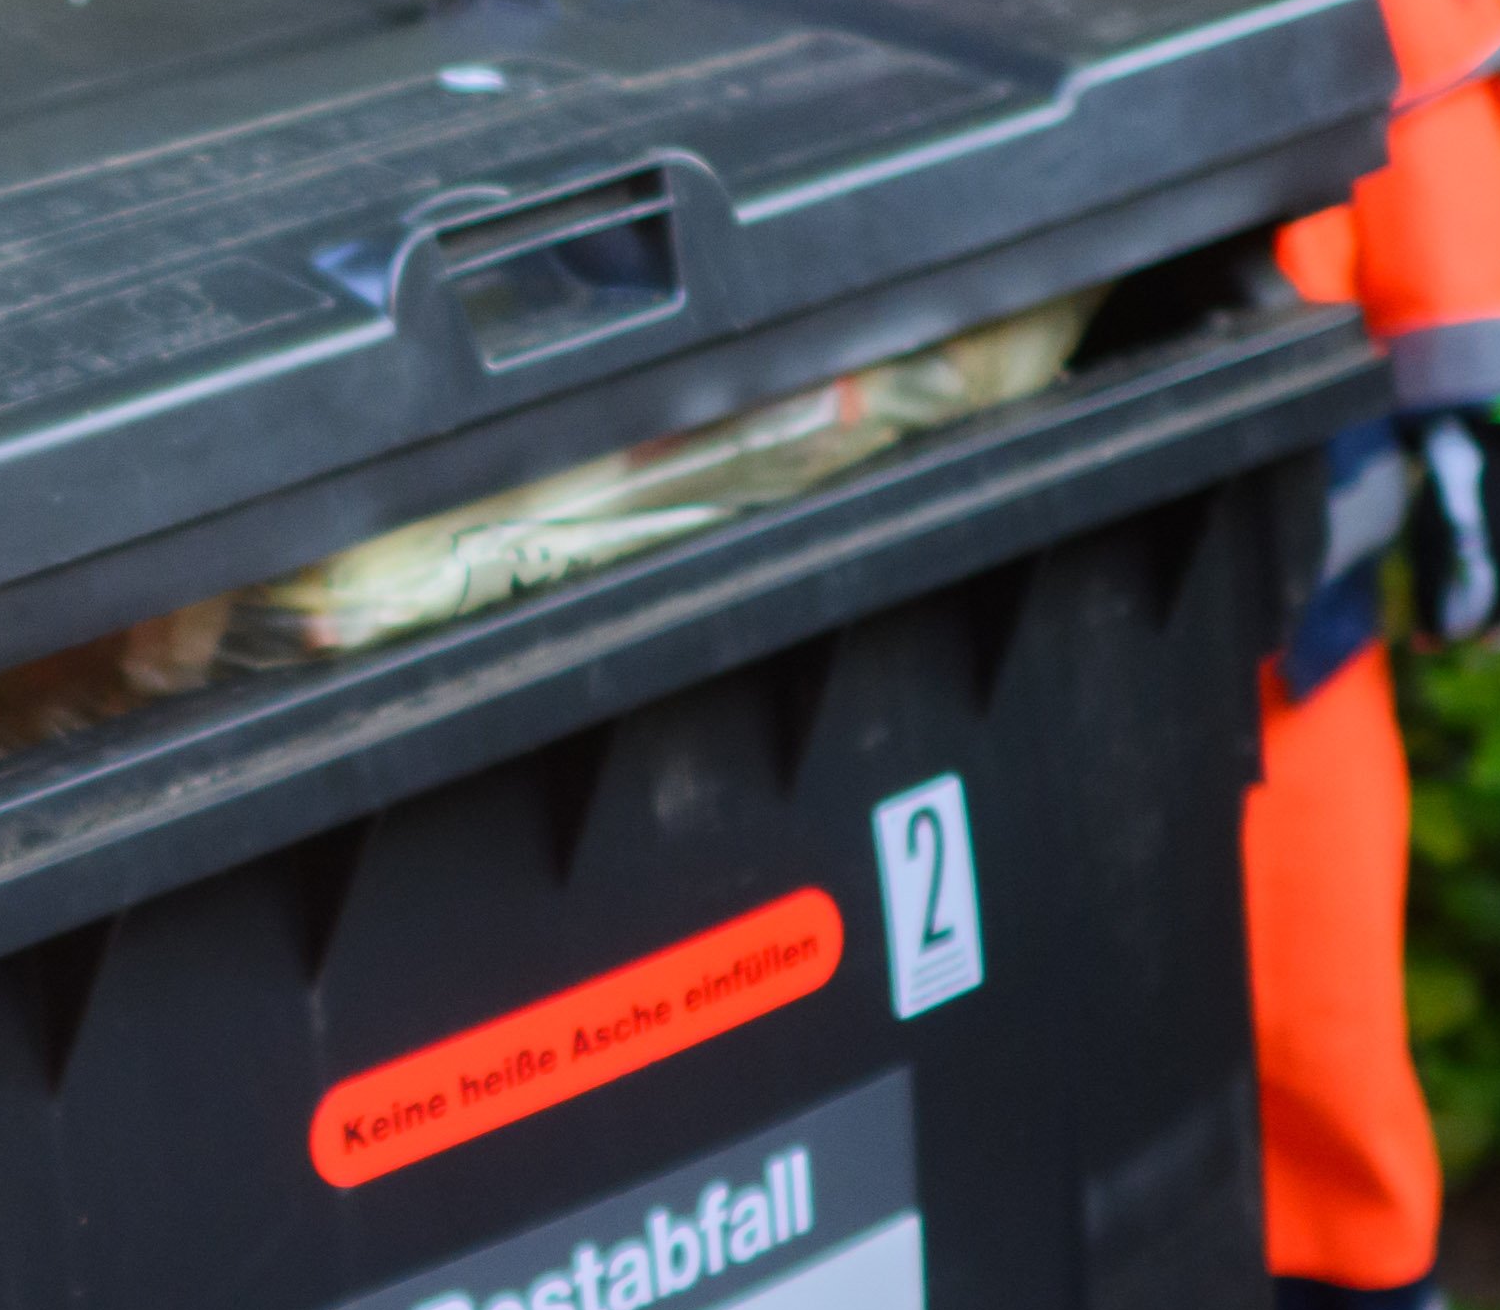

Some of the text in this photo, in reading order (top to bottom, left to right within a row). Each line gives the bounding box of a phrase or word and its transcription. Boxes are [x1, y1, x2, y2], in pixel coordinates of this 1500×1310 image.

[906, 805, 955, 955] 2
[341, 933, 820, 1155] Keine heiße Asche einfüllen
